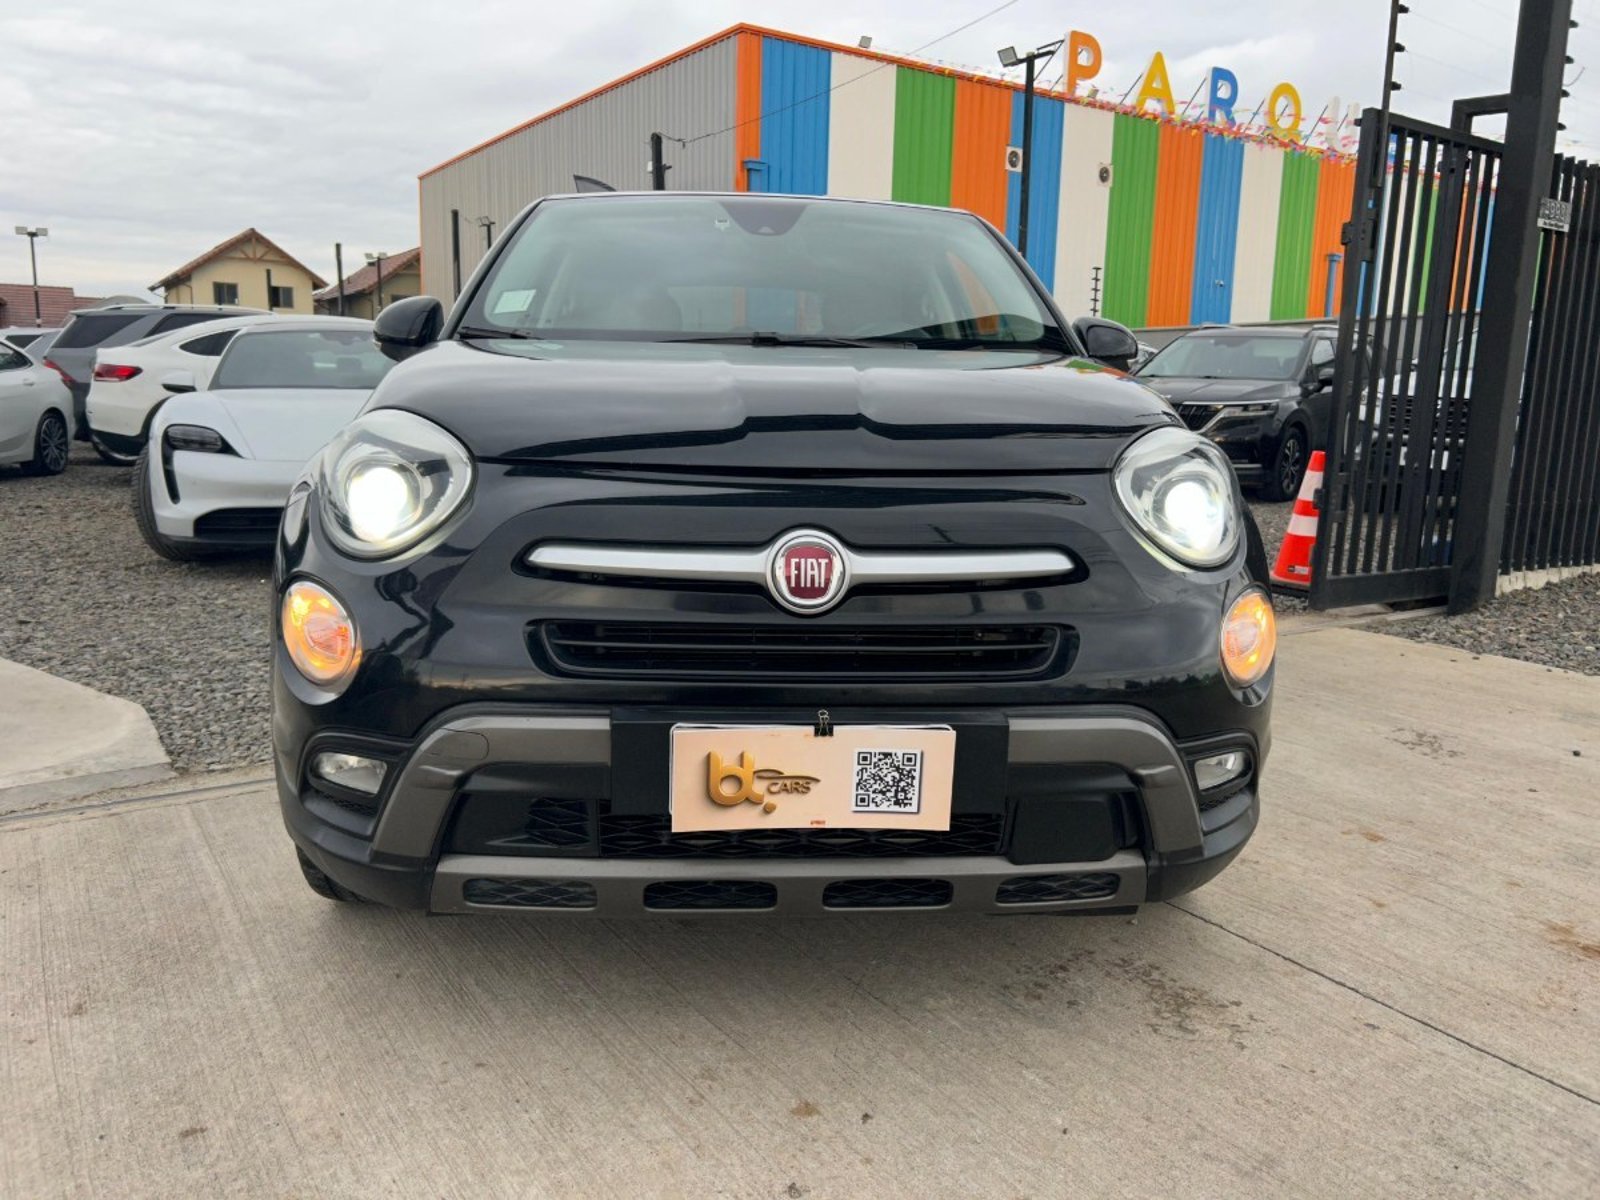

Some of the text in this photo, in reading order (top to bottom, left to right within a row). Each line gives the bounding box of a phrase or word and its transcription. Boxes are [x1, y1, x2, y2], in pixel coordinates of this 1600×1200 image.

[1063, 30, 1398, 163] PARQU
[790, 558, 829, 588] FIAT
[767, 781, 812, 794] CARS
